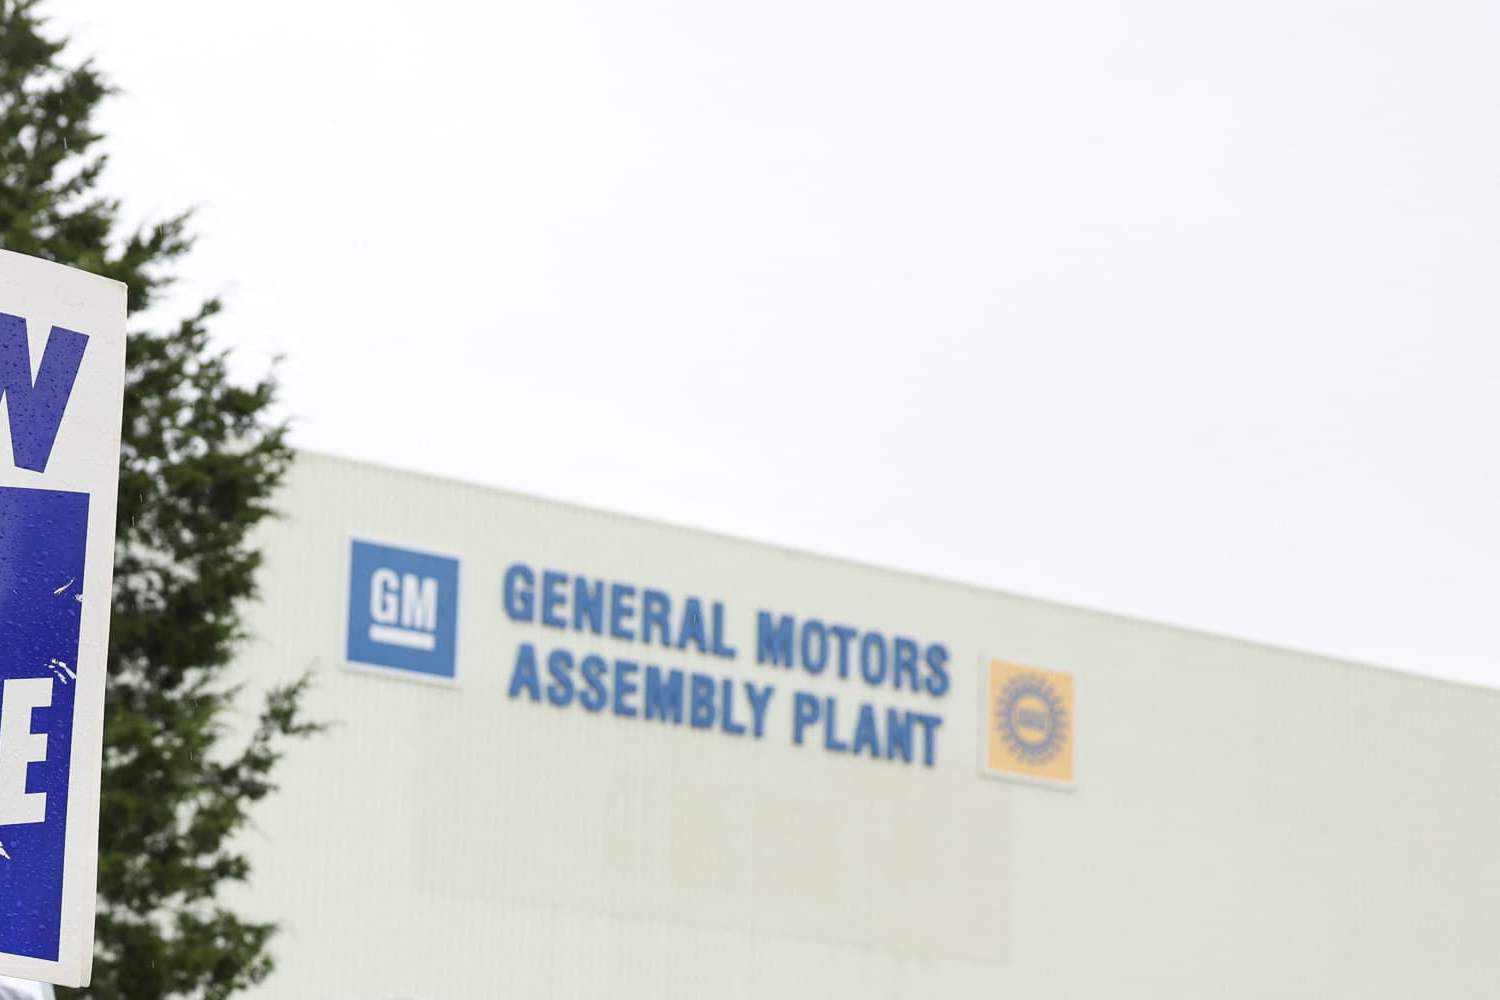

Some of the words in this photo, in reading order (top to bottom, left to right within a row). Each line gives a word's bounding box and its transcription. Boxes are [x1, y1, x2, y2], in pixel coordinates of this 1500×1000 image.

[368, 566, 438, 631] GM
[503, 563, 738, 660] GENERAL
[755, 610, 952, 699] MOTORS
[507, 642, 777, 739] ASSEMBLY
[793, 690, 943, 767] PLANT
